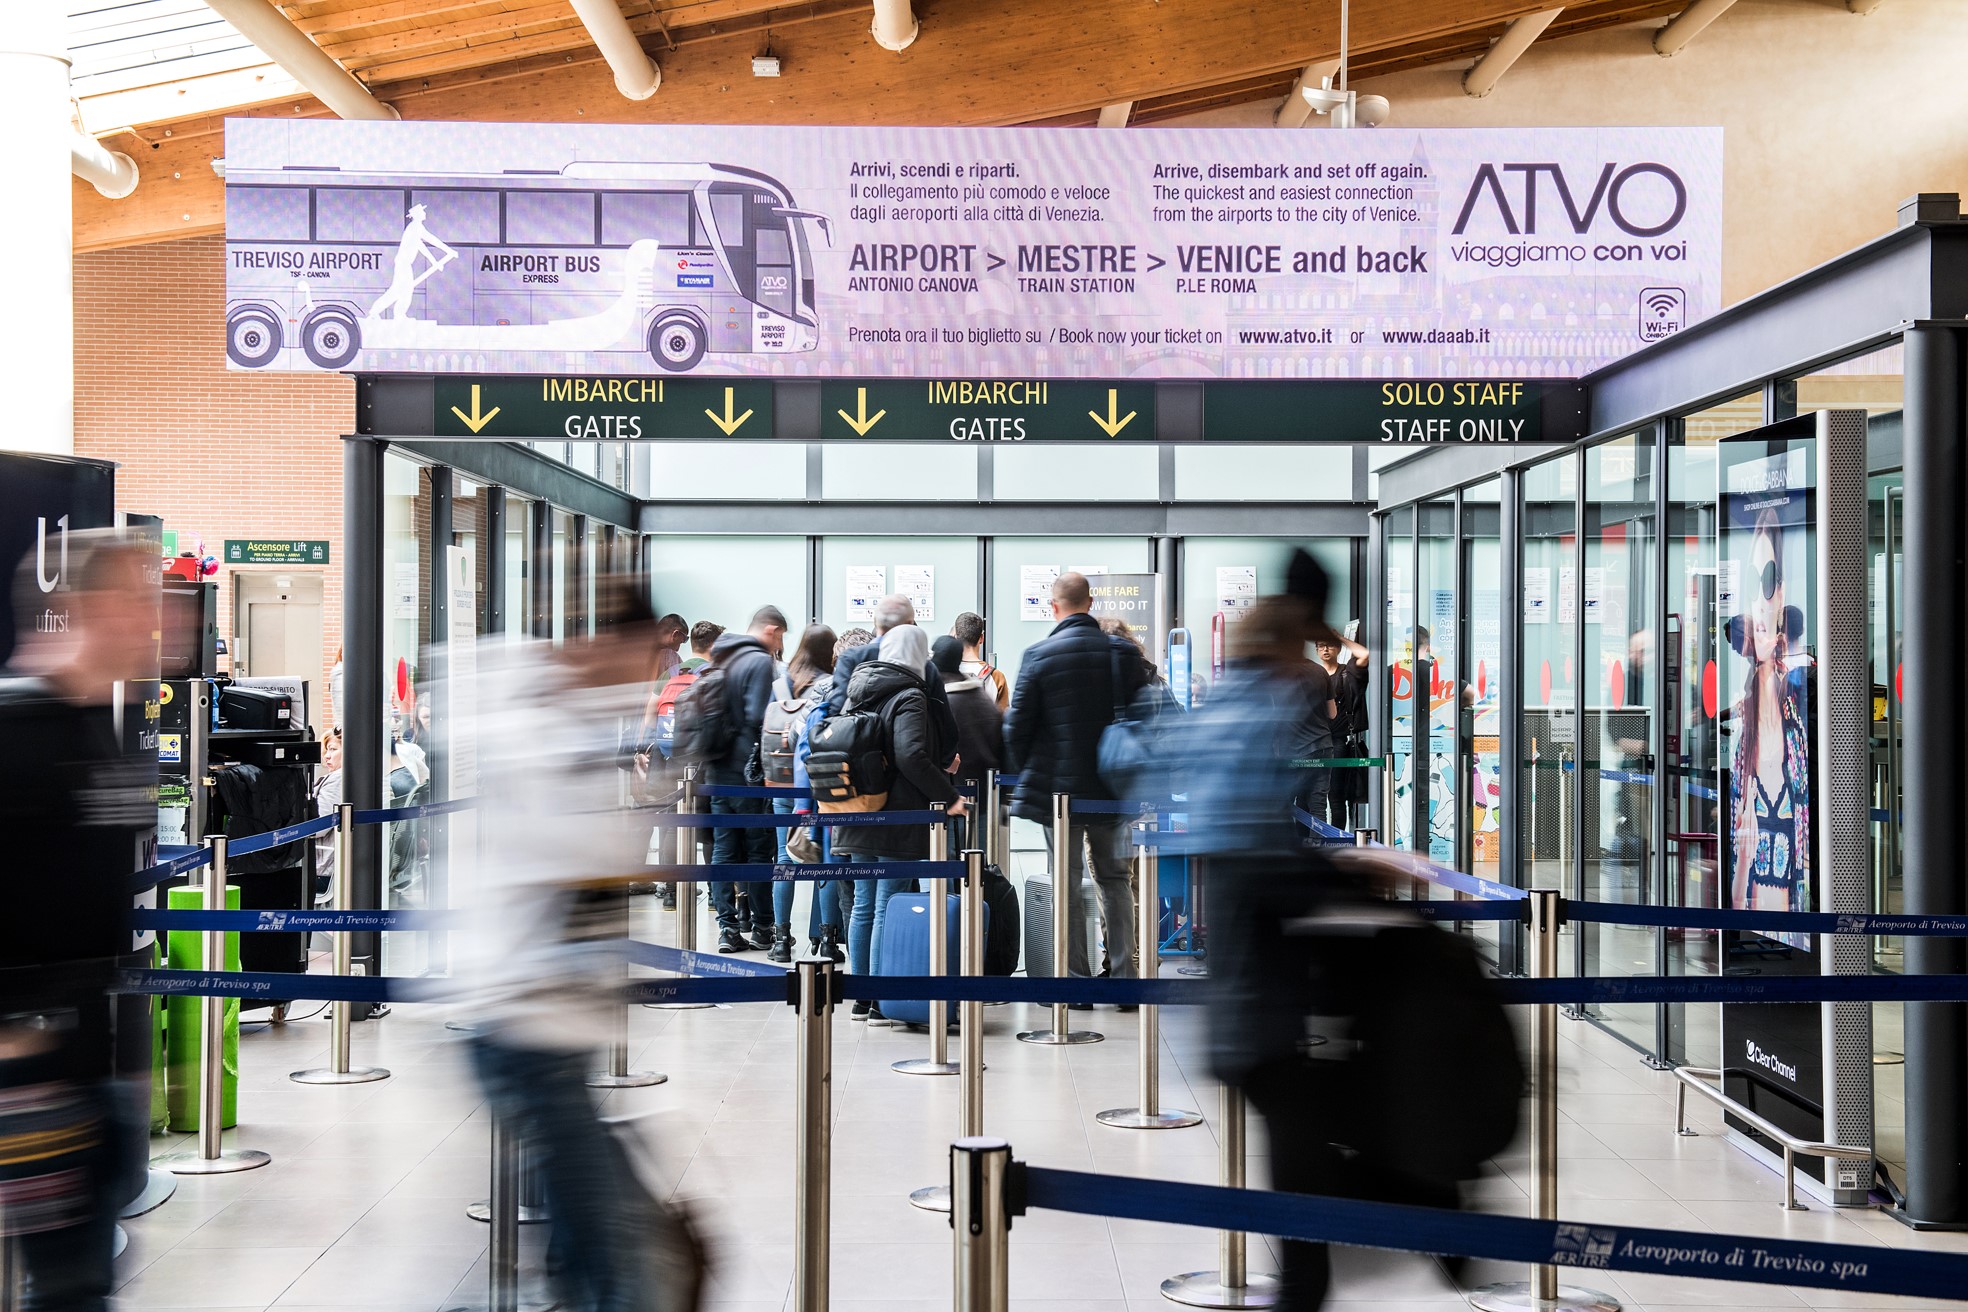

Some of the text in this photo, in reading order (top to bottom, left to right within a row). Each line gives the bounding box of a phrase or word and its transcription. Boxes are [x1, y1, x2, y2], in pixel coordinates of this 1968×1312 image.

[850, 162, 1020, 180] Arrivi, scendi e riparti.
[1153, 163, 1428, 182] Arrive, disembark and set off again.
[850, 184, 1110, 203] Il collegamento più comodo e veloce
[1153, 185, 1413, 203] The quickest and easiest connection
[1451, 162, 1687, 238] ATVO
[850, 205, 1105, 224] dagli aeroporti alla città di Venezia.
[1153, 207, 1421, 225] from the airports to the city of Venice.
[231, 251, 383, 270] TREVISO AIRPORT
[849, 244, 1428, 273] AIRPORT MESTRE VENICE and back
[1451, 240, 1687, 268] viaggiamo con voi
[481, 255, 601, 273] AIRPORT BUS
[522, 275, 559, 284] EXPRESS
[761, 276, 787, 287] ATVO
[848, 277, 979, 293] ANTONIO CANOVA
[1017, 278, 1135, 293] TRAIN STATION
[1176, 278, 1257, 294] P.LE ROMA
[1646, 322, 1678, 332] Wi-Fi
[849, 326, 901, 343] Prenota
[905, 330, 927, 343] ora
[932, 327, 938, 343] il
[943, 328, 964, 343] tuo
[968, 327, 1021, 347] biglietto
[1025, 331, 1041, 343] su
[1059, 327, 1094, 343] Book
[1098, 331, 1126, 343] now
[1131, 331, 1161, 347] your
[1164, 328, 1202, 344] ticket
[1205, 332, 1222, 344] on
[1239, 329, 1332, 344] www.atvo.it
[1350, 332, 1364, 344] or
[1382, 328, 1491, 344] www.daaab.it
[543, 379, 664, 403] IMBARCHI
[928, 381, 1048, 405] IMBARCHI
[1382, 383, 1523, 406] SOLO STAFF
[565, 415, 642, 439] GATES
[950, 417, 1026, 441] GATES
[1381, 419, 1525, 442] STAFF ONLY
[247, 542, 307, 552] Ascensore Lift
[1114, 586, 1139, 596] FARE
[1104, 601, 1116, 611] TO
[1120, 601, 1135, 611] DO
[1138, 600, 1148, 611] IT
[36, 609, 70, 633] ufirst
[797, 867, 886, 877] Aeroporto di Treviso spa
[288, 915, 396, 926] Aeroporto di Treviso spa
[1869, 919, 1966, 931] Aeroporto di Treviso
[696, 958, 721, 973] Aeroporto
[727, 963, 745, 977] Treviso
[144, 976, 271, 992] Aeroporto di Treviso spa
[658, 986, 677, 998] spa
[1755, 1046, 1796, 1082] Clear Channel
[1619, 1239, 1869, 1280] Aeroporto di Treviso spa
